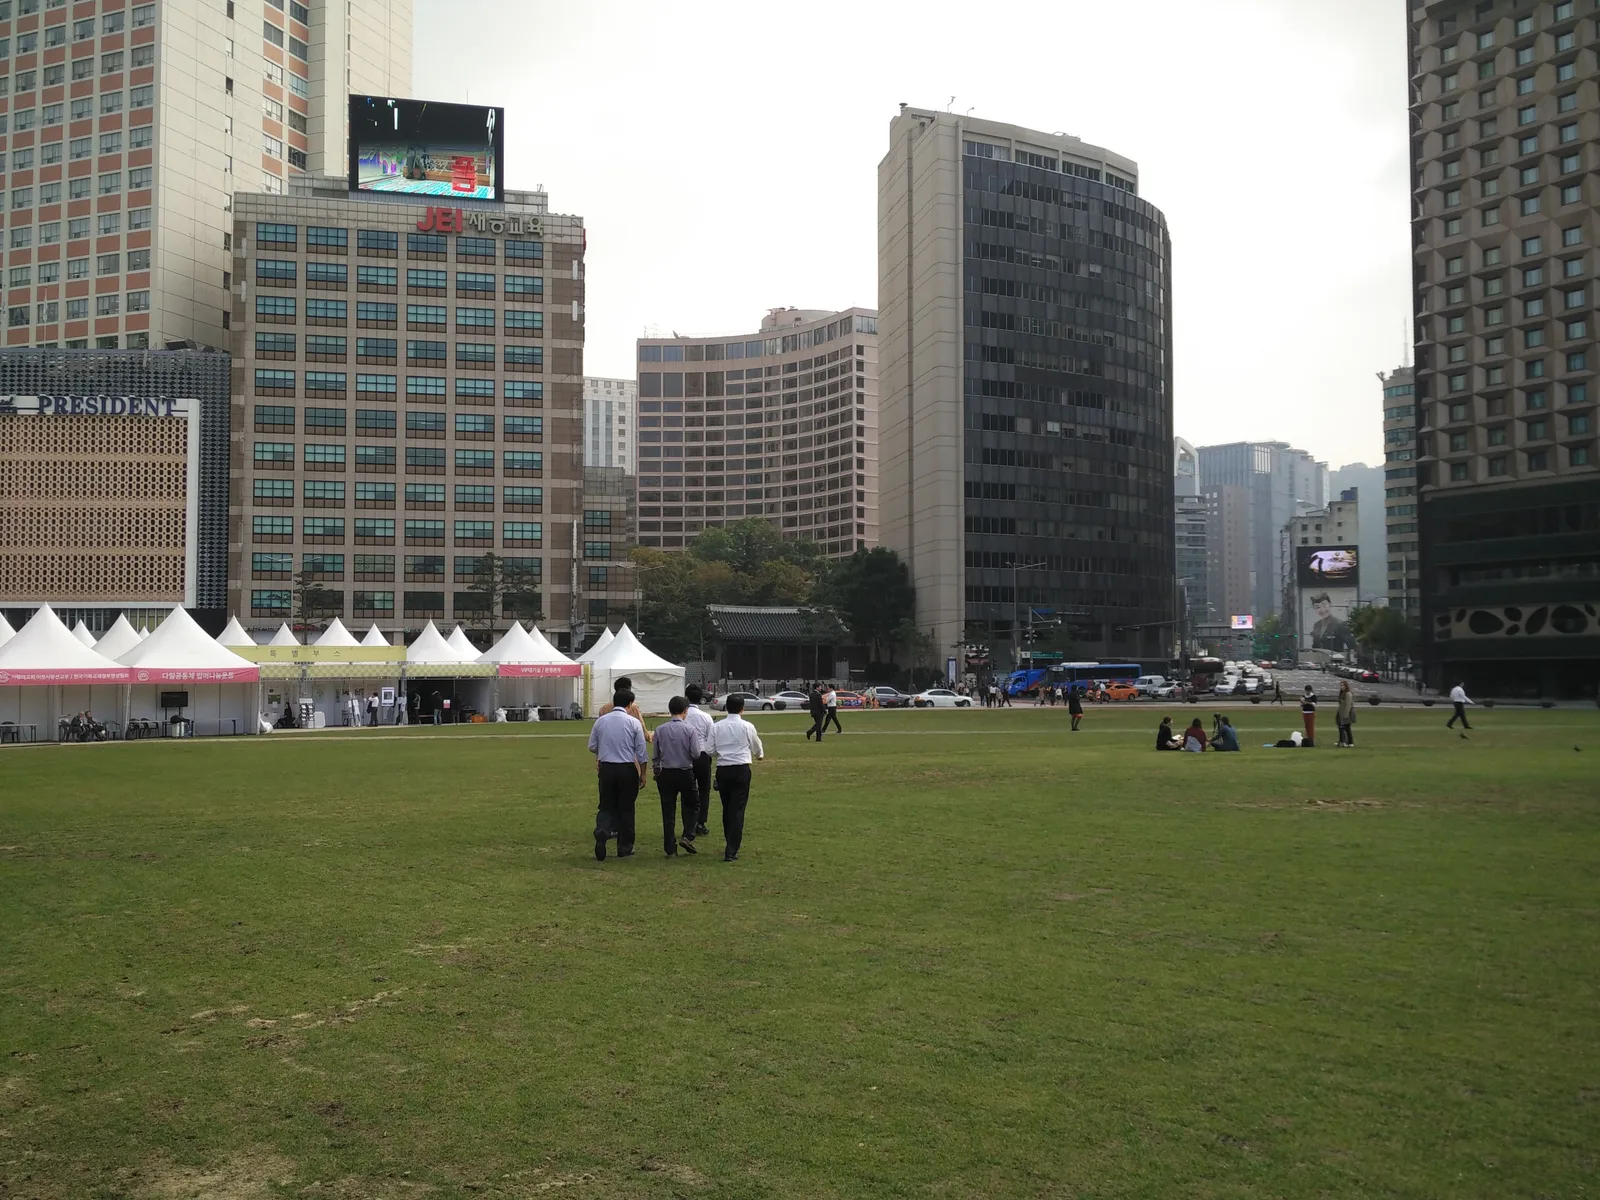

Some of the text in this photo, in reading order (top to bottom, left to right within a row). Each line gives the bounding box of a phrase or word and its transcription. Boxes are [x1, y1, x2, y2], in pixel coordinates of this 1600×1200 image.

[416, 206, 543, 237] JEI 재능교육
[37, 395, 177, 417] PRESIDENT
[161, 671, 195, 680] 다일공동체
